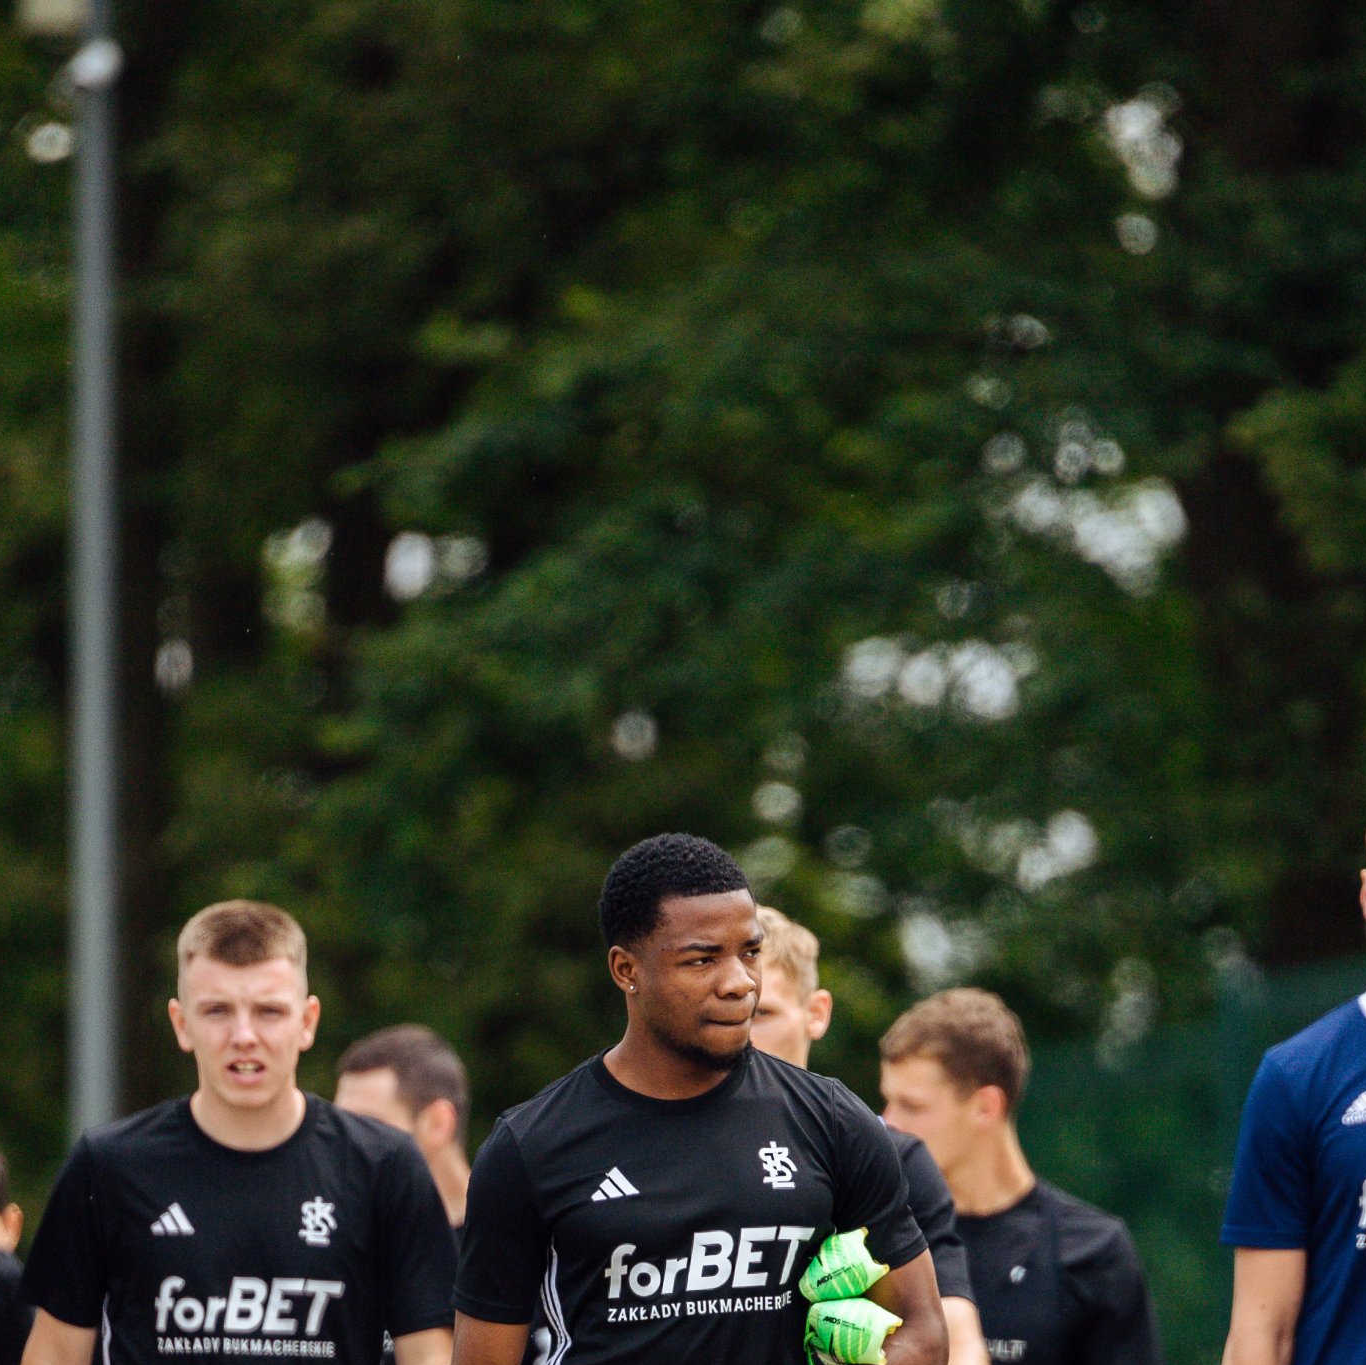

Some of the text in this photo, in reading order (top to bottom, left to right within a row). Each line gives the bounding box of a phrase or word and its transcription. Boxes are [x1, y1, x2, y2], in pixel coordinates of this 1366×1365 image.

[605, 1225, 816, 1299] forBET
[155, 1275, 346, 1336] forBET
[607, 1302, 682, 1322] ZAKŁADY
[157, 1336, 221, 1354] ZAKŁADY
